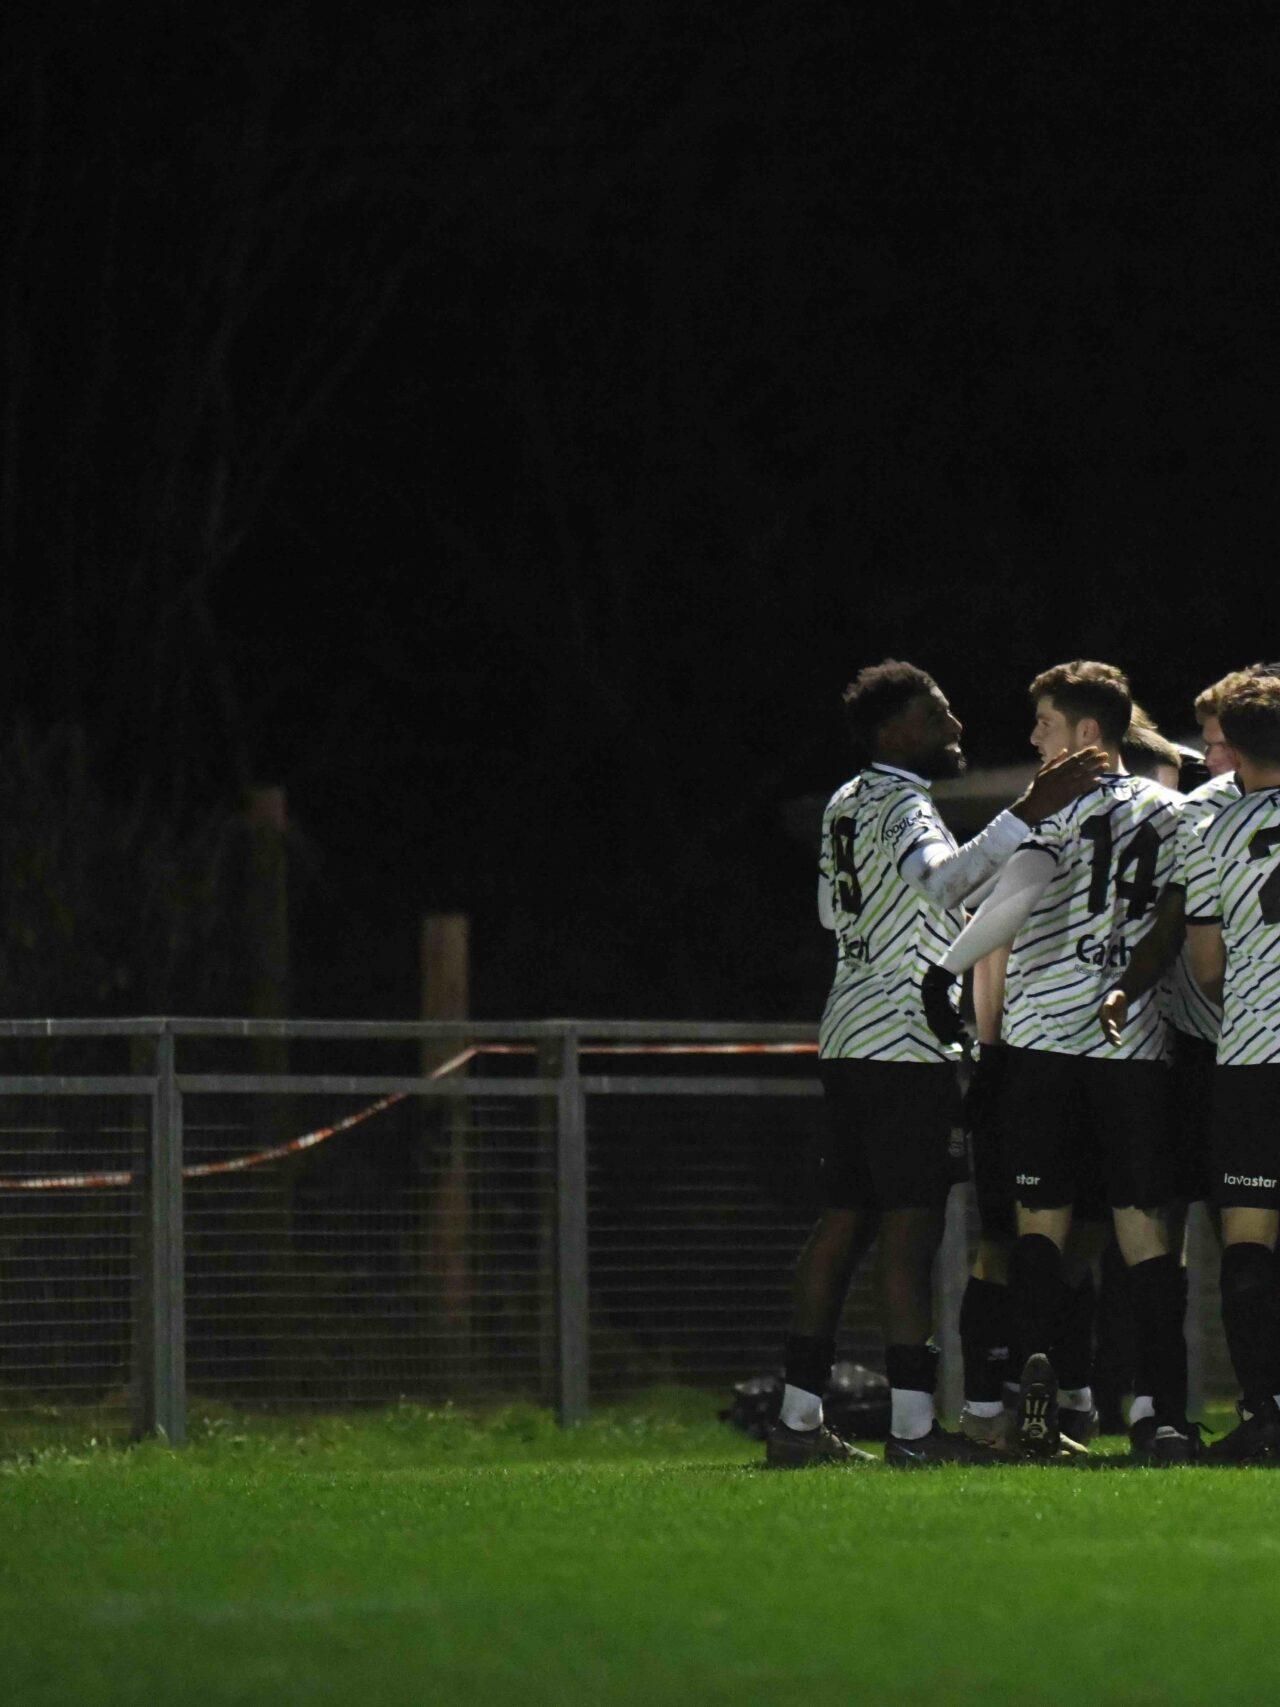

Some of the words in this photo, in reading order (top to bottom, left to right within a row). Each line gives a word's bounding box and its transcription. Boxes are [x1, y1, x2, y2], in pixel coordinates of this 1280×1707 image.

[1079, 815, 1161, 920] 14
[1016, 1174, 1040, 1185] star
[1224, 1172, 1277, 1188] lavastar
